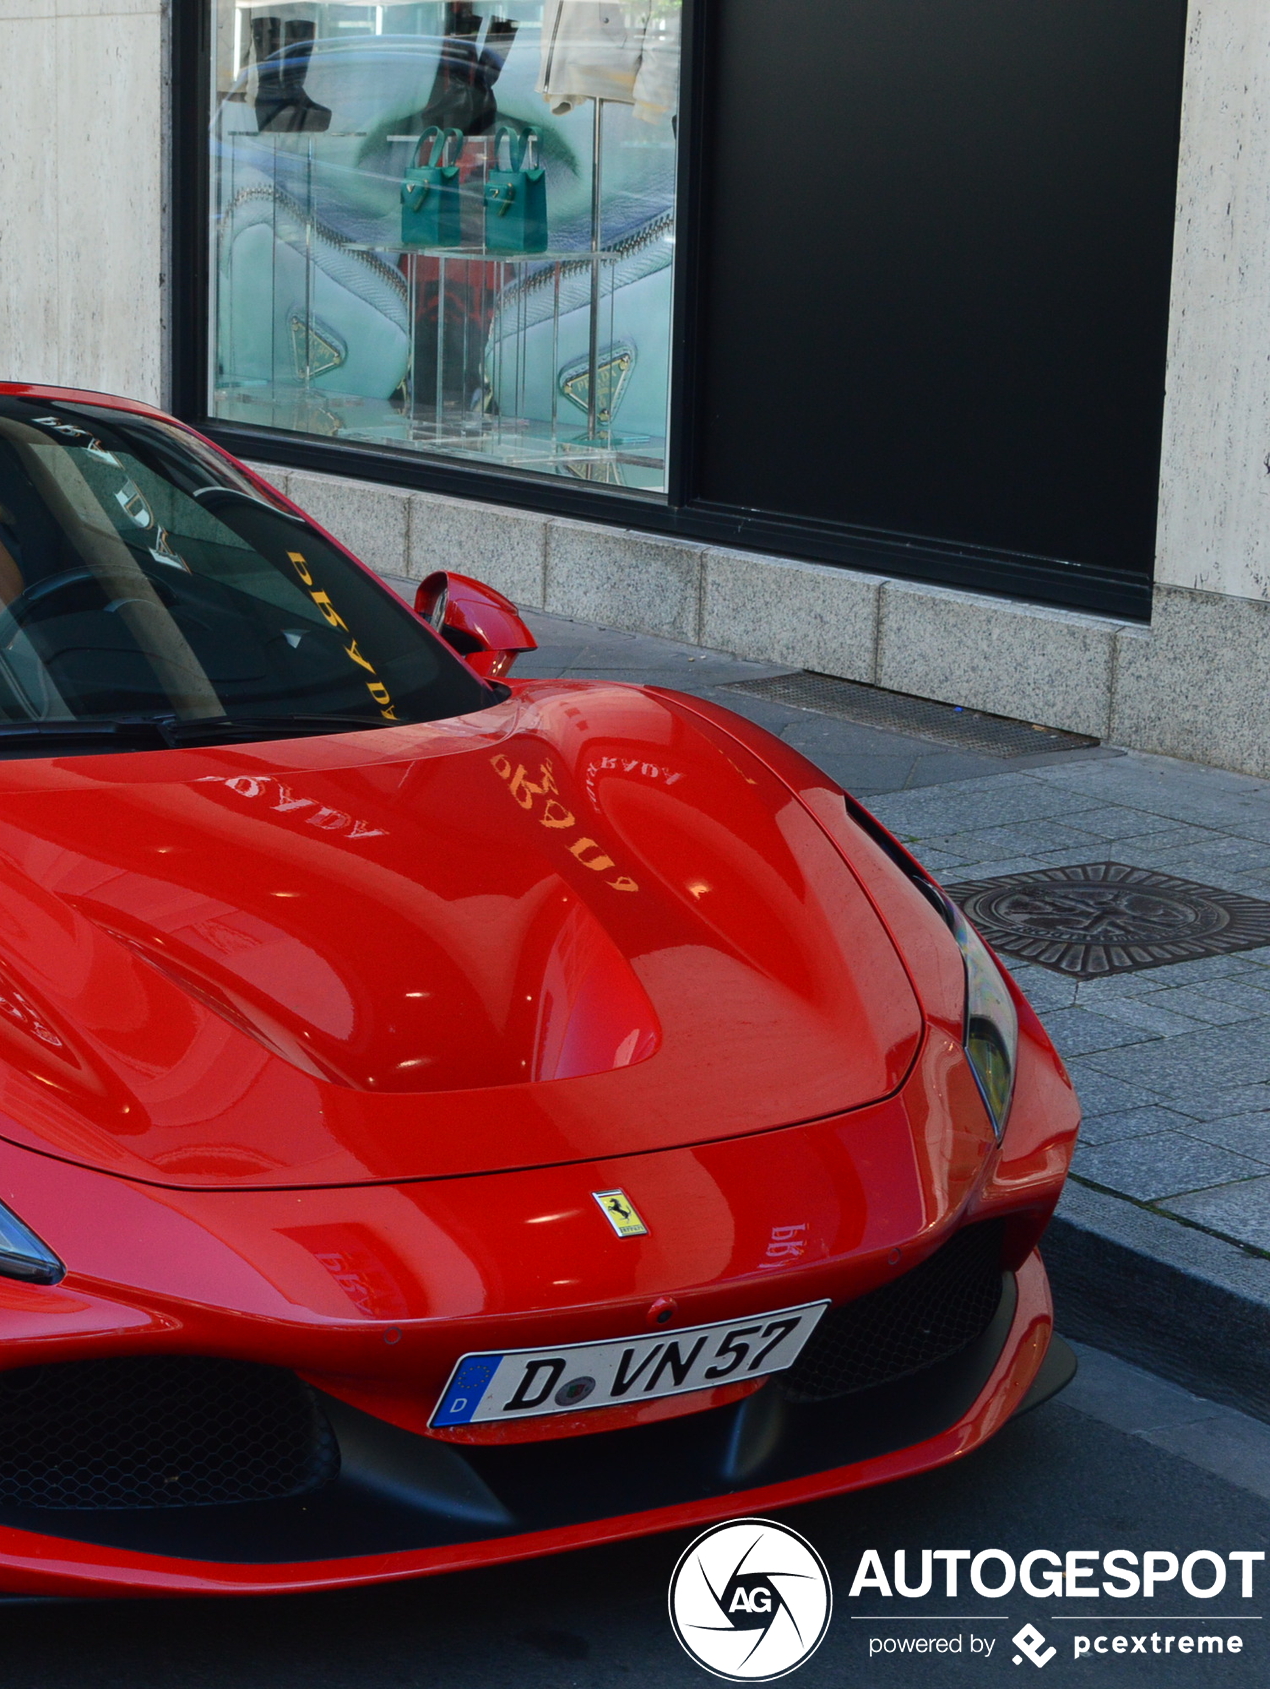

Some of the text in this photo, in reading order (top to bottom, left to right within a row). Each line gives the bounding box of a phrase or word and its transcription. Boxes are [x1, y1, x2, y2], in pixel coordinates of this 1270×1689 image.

[503, 1316, 803, 1411] D VN 57
[449, 1398, 468, 1413] D
